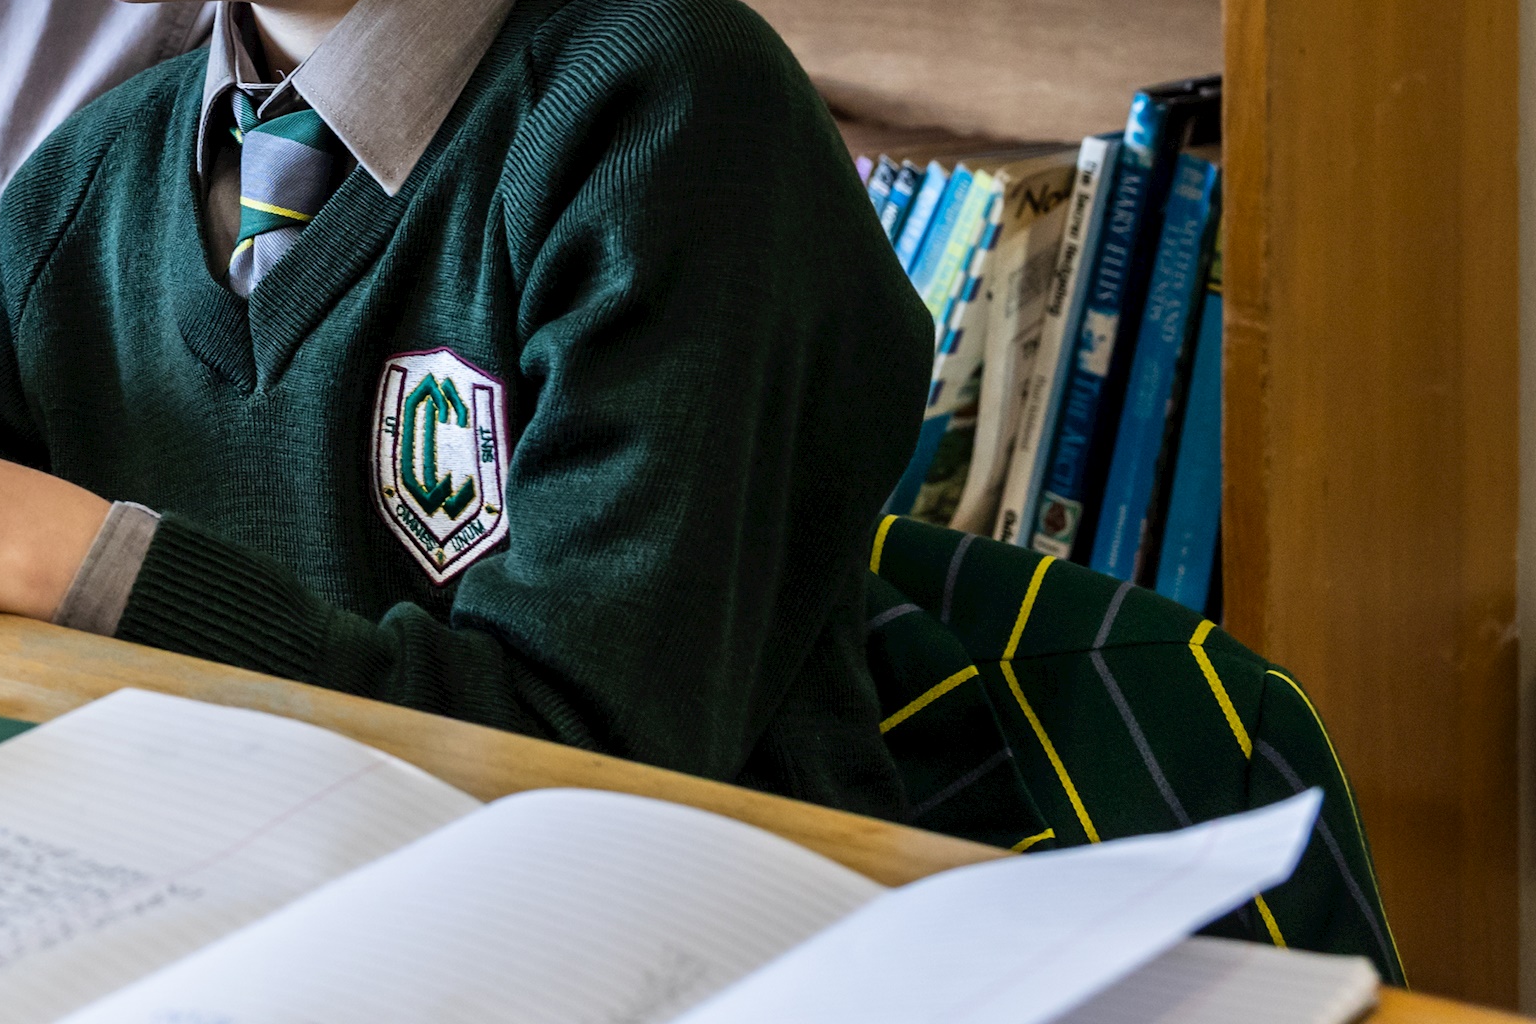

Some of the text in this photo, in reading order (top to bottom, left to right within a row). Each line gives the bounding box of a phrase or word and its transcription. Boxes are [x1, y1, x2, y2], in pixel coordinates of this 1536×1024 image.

[1080, 159, 1098, 188] The
[1105, 170, 1146, 242] MARY
[1068, 191, 1091, 238] Secret
[382, 415, 495, 552] UT OMNES UNUM SINT
[1044, 424, 1089, 499] ARCTI
